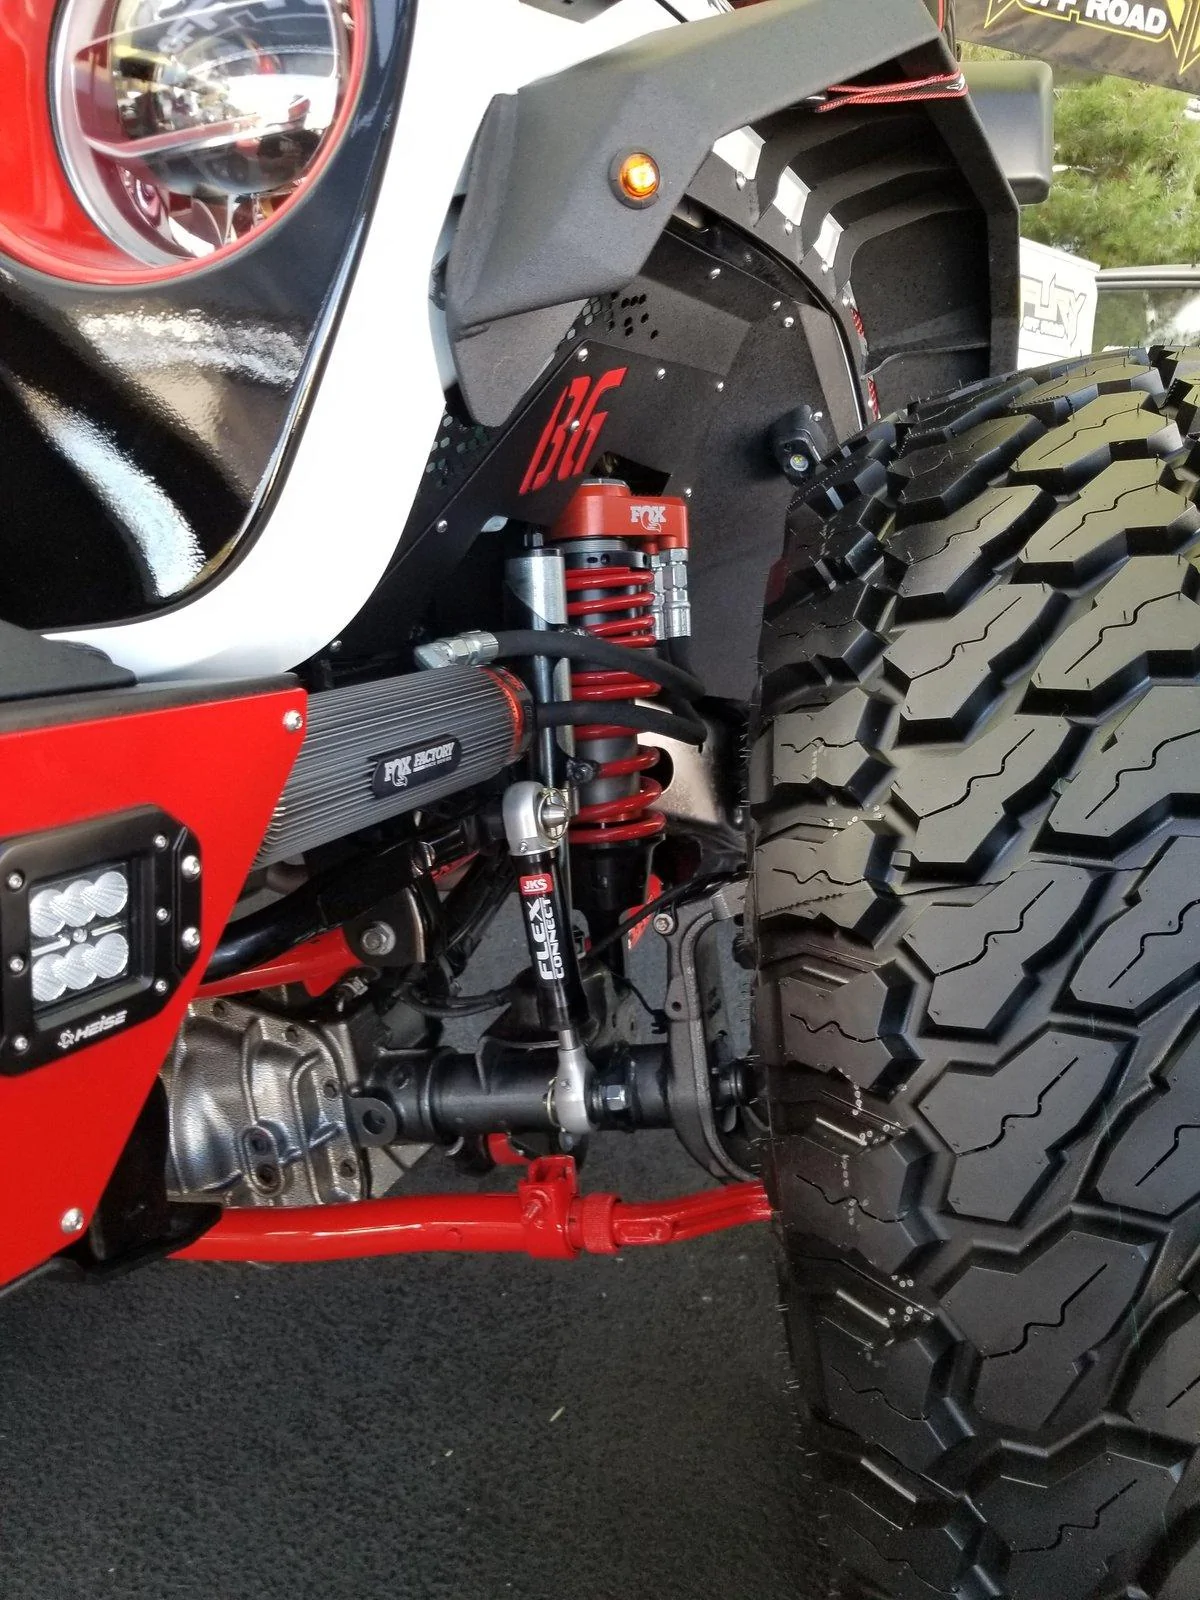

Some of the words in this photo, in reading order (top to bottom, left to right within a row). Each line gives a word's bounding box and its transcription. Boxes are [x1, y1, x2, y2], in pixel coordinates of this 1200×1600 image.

[1085, 0, 1167, 34] ROAD
[630, 505, 667, 531] FOX
[384, 756, 412, 784] FOX
[413, 742, 455, 768] FACTORY
[524, 879, 548, 891] JKS
[527, 897, 555, 980] FLEX
[543, 899, 565, 979] CONNECT
